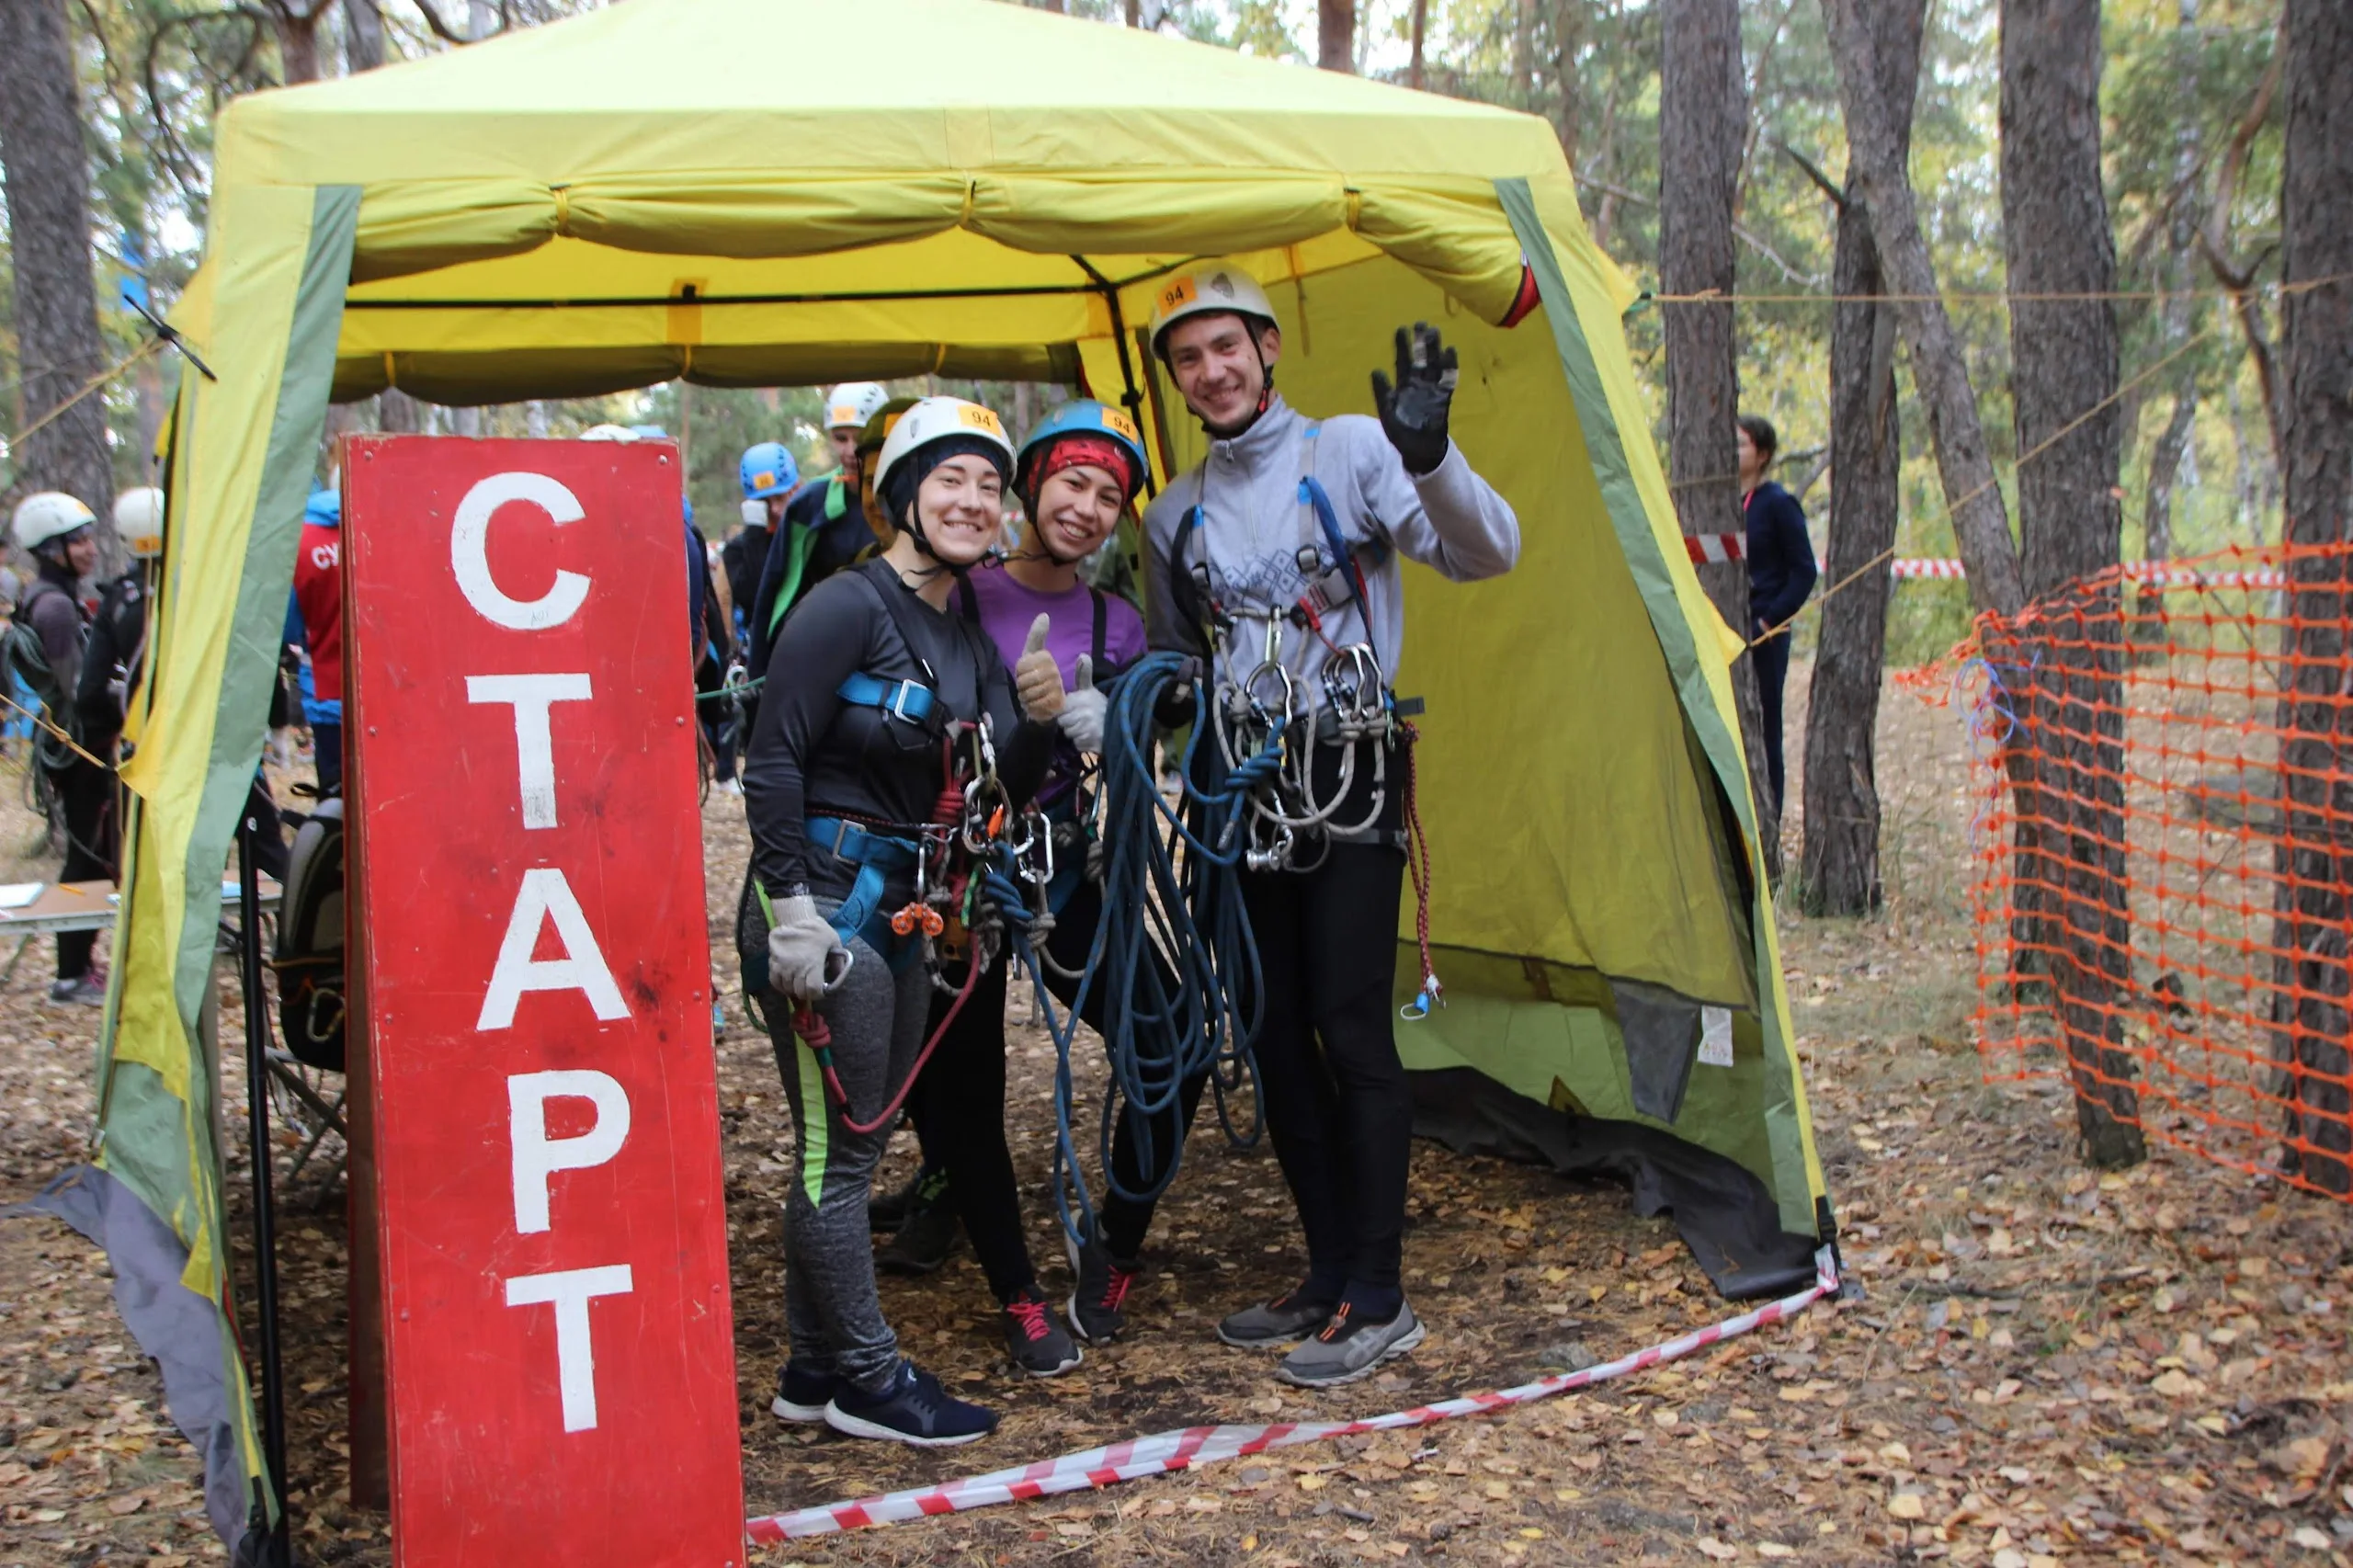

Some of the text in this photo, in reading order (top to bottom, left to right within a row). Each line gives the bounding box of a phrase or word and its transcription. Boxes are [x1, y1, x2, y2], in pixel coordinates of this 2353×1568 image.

[1165, 285, 1184, 307] 94
[972, 410, 991, 427] 94
[1114, 415, 1130, 434] 94
[450, 471, 634, 1434] СТАРТ
